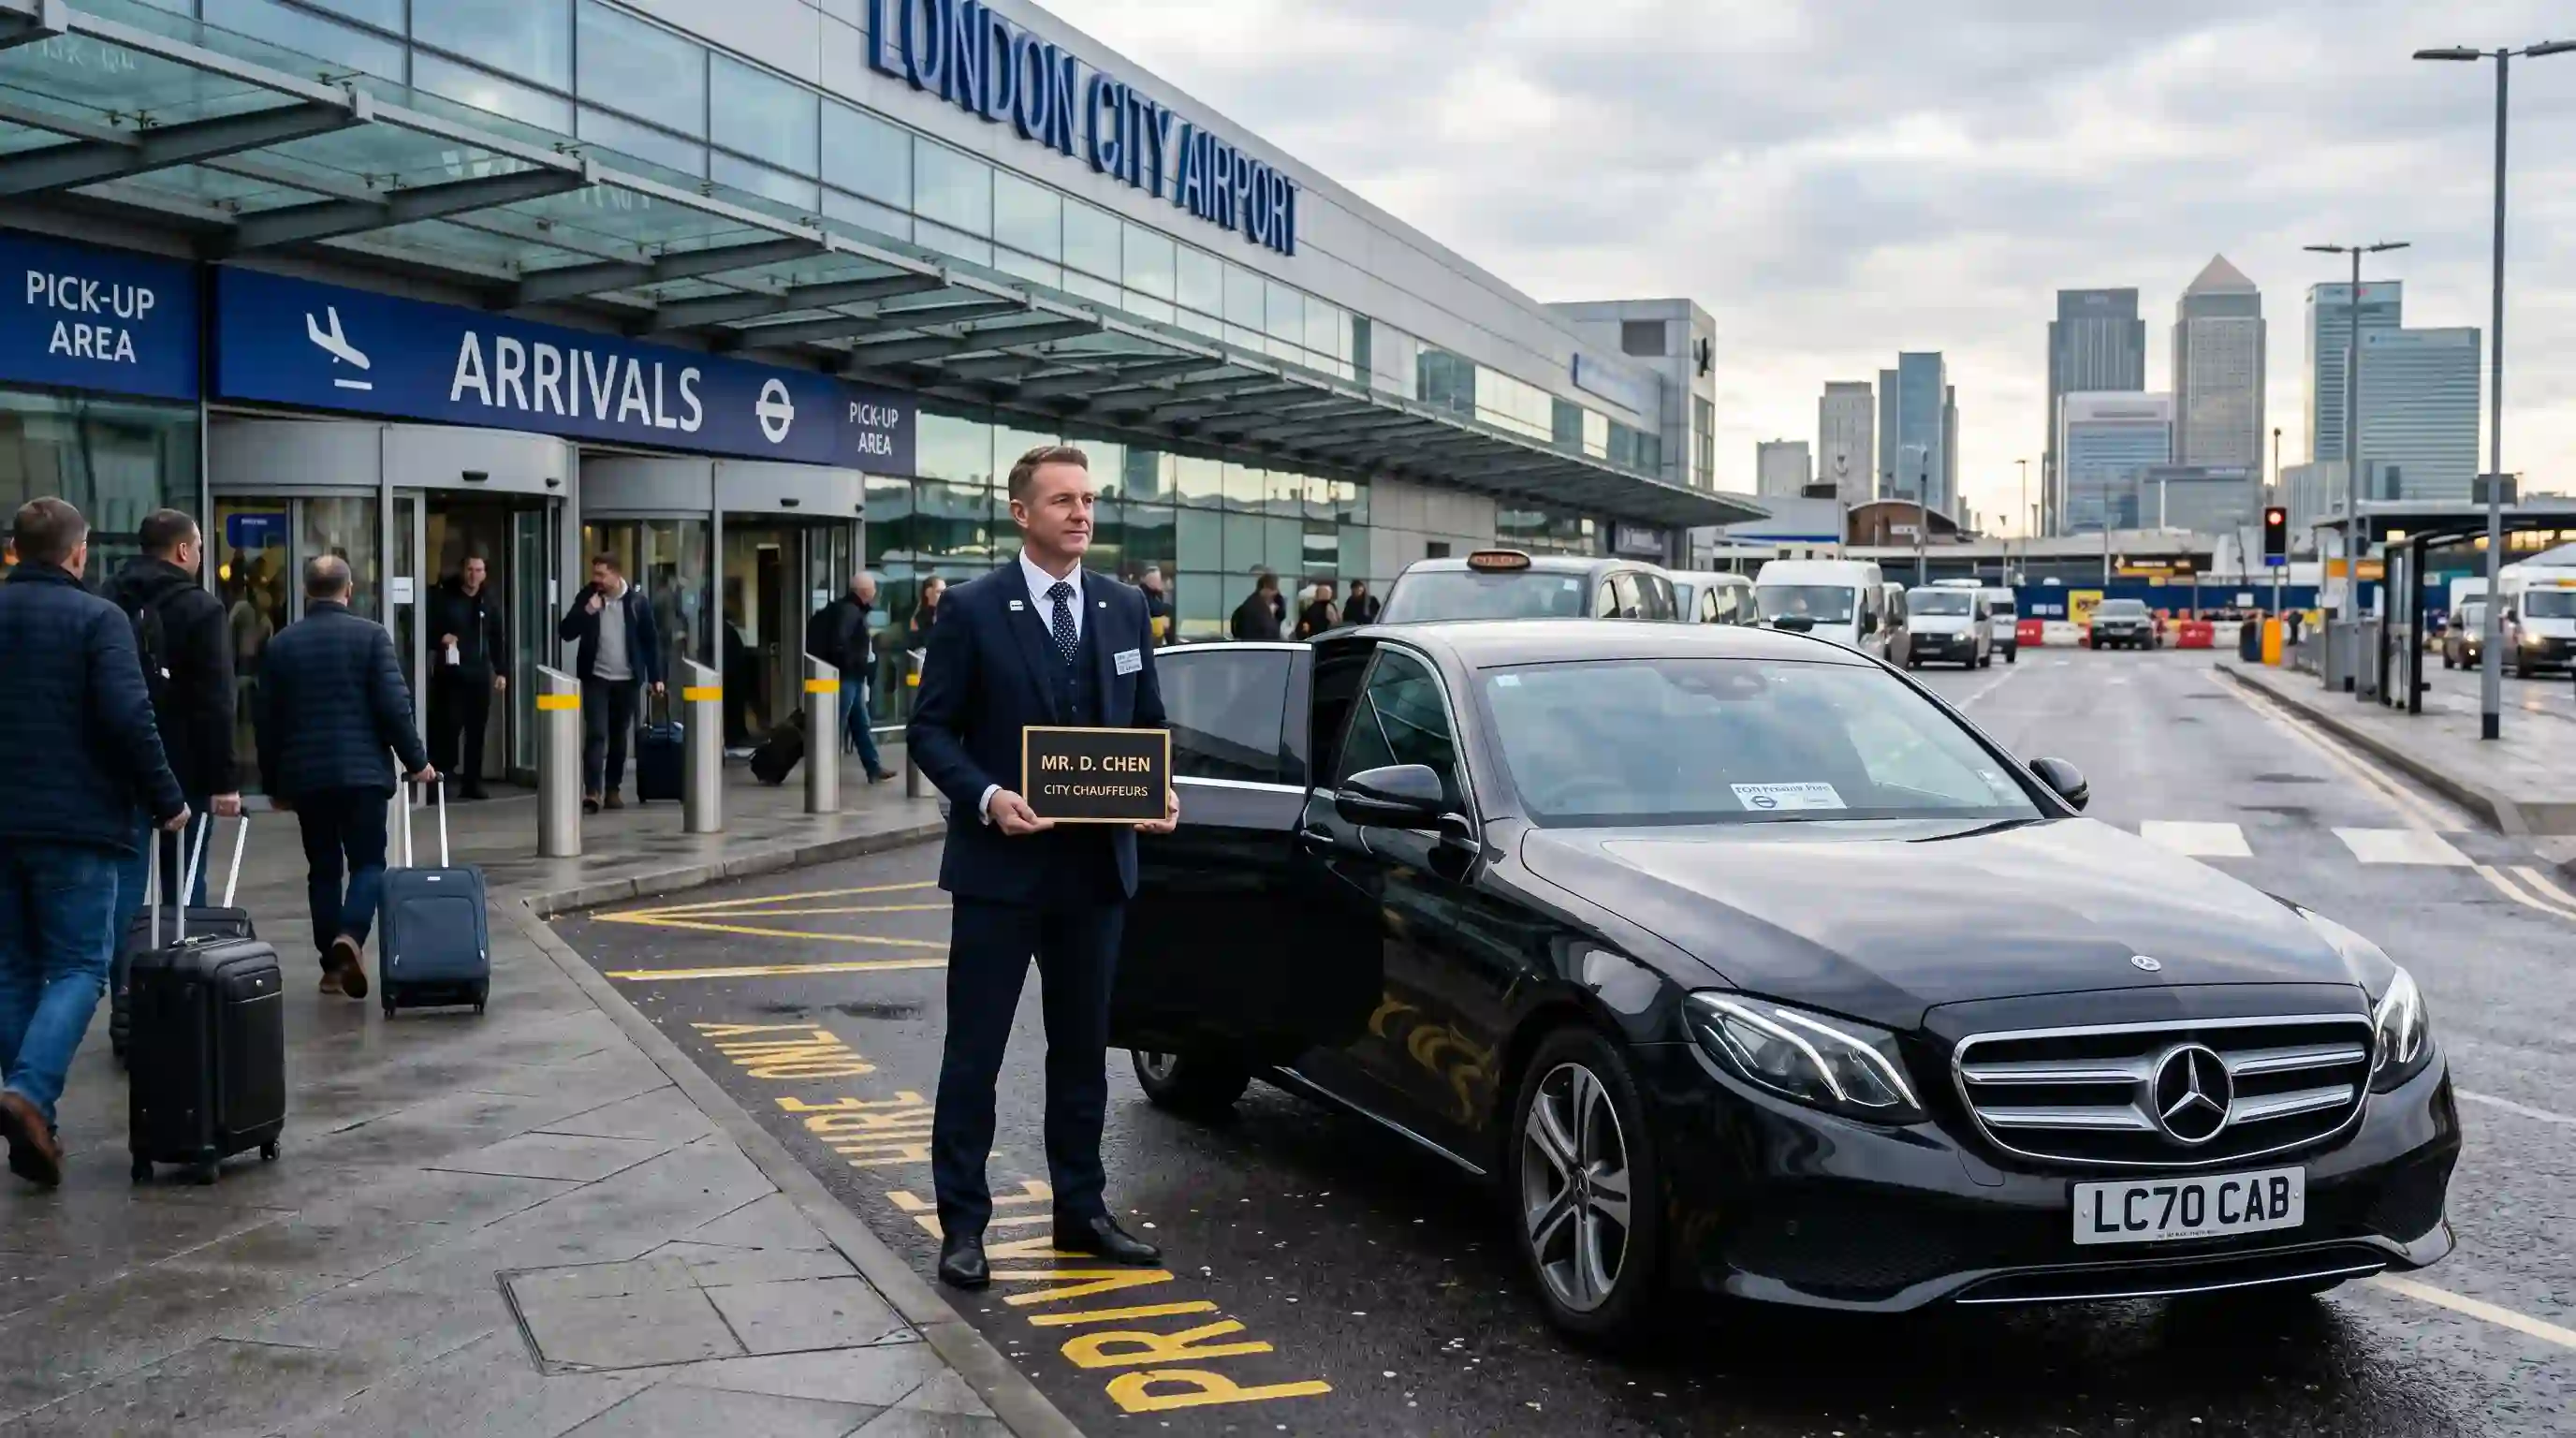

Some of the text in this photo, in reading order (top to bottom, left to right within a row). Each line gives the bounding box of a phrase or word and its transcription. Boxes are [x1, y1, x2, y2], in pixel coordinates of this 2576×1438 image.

[869, 0, 1301, 257] LONDON CITY AIRPORT
[25, 270, 154, 320] PICK-UP
[48, 320, 137, 364] AREA
[449, 330, 704, 433] ARRIVALS
[849, 402, 900, 429] PICK-UP
[857, 432, 892, 456] AREA
[1041, 755, 1150, 772] MR. D. CHEN
[1044, 784, 1149, 797] CITY CHAUFFEURS
[689, 1022, 876, 1078] ONLY
[2094, 1176, 2290, 1233] LC70 CAB
